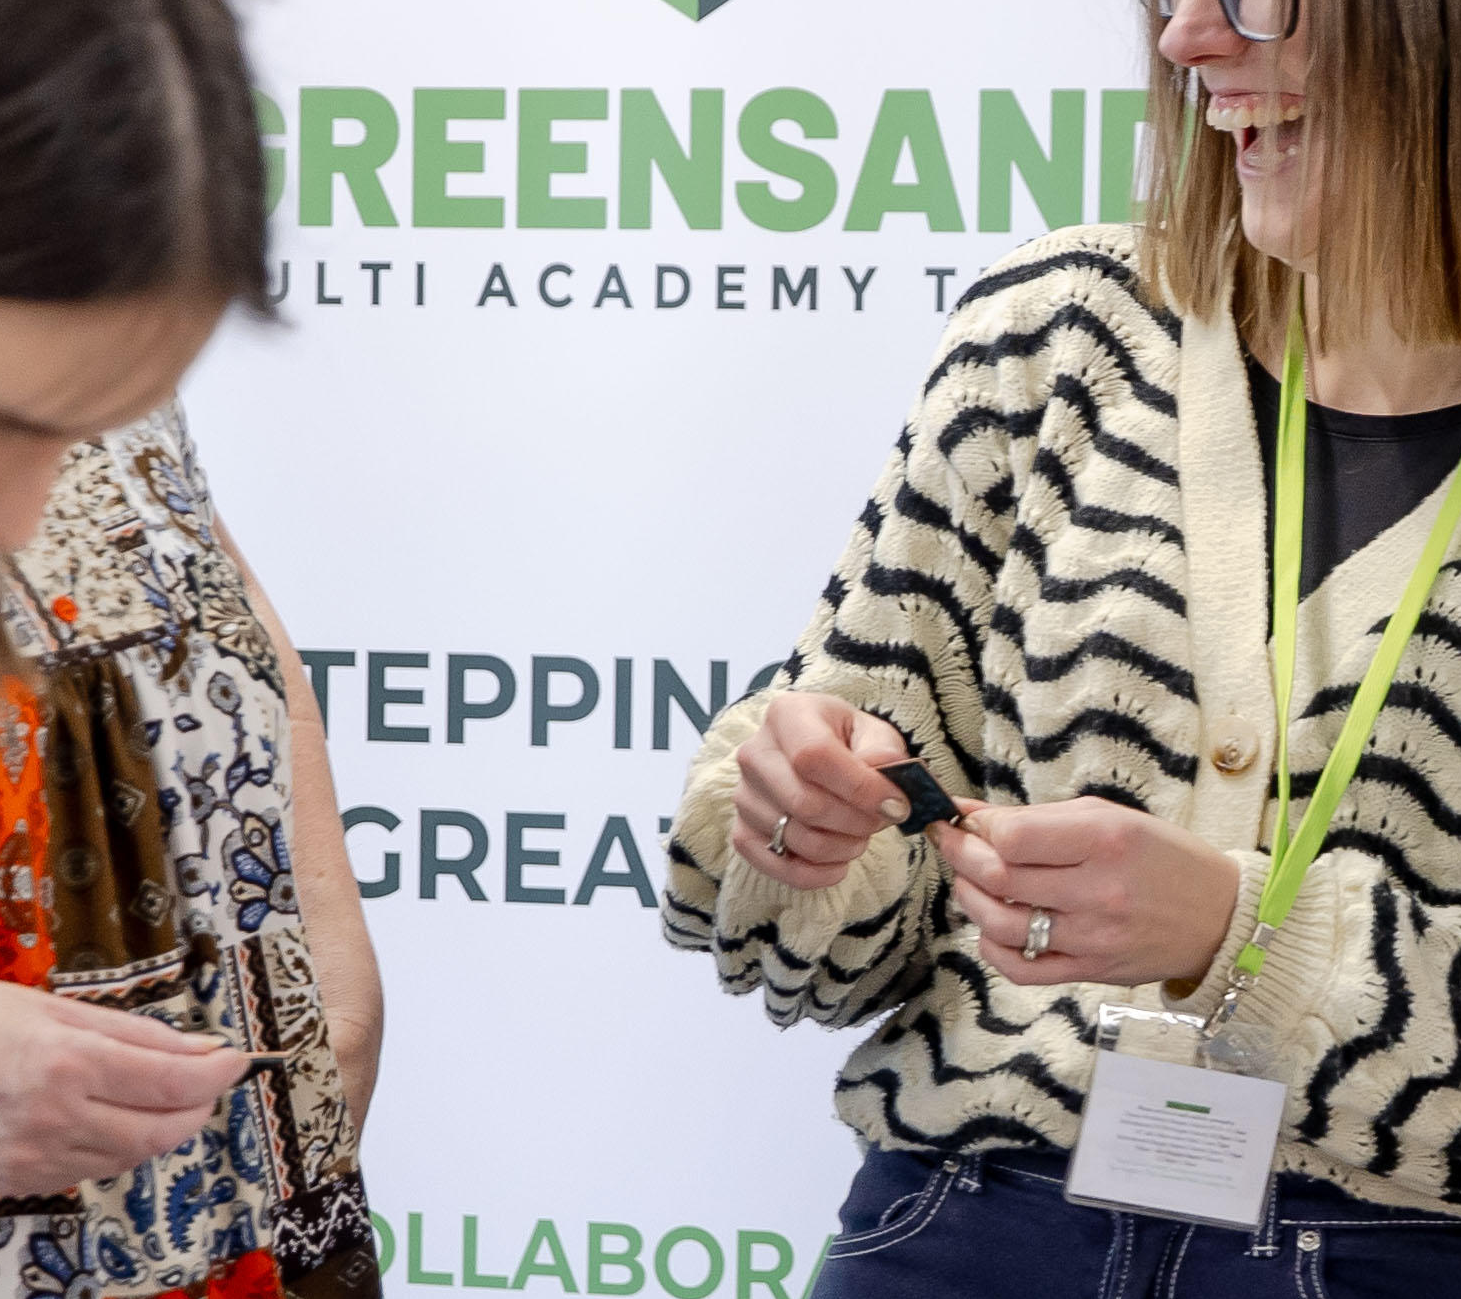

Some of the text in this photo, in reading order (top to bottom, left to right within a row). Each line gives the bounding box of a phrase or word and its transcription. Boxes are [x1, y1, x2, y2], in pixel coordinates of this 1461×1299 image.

[266, 261, 425, 306] ULTI
[476, 261, 881, 313] ACADEMY
[298, 649, 790, 751] TEPPIN
[341, 805, 672, 909] GREA
